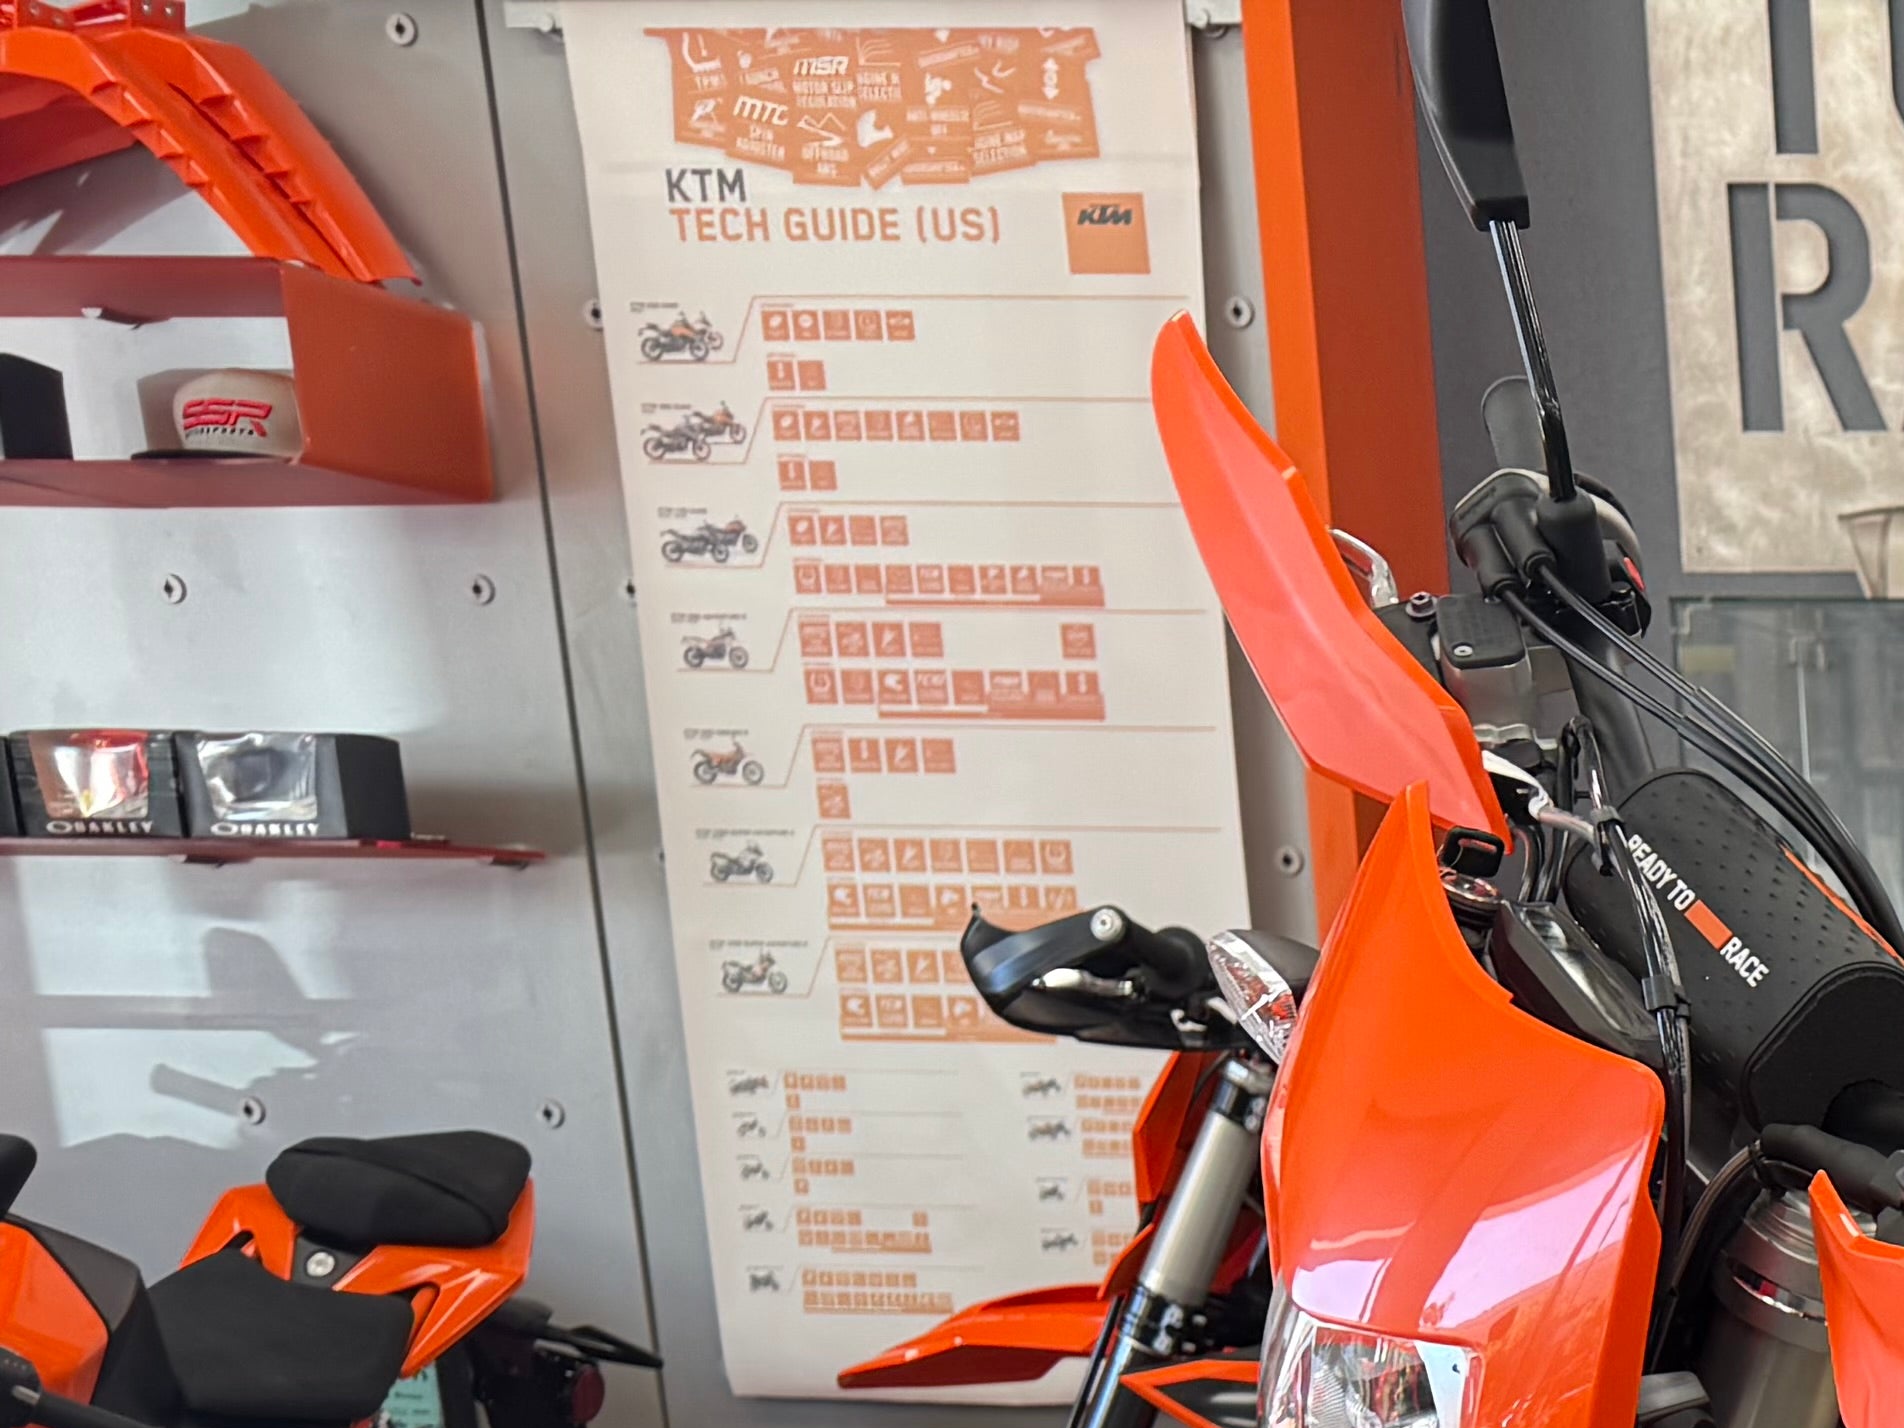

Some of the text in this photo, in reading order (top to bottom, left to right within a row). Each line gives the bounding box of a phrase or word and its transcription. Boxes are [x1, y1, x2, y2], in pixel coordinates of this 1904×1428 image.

[733, 95, 790, 126] MTC
[666, 169, 746, 202] KTM
[669, 207, 1001, 244] TECH GUIDE (US)
[1077, 204, 1134, 227] KTM
[1628, 834, 1769, 988] READY TO RACE
